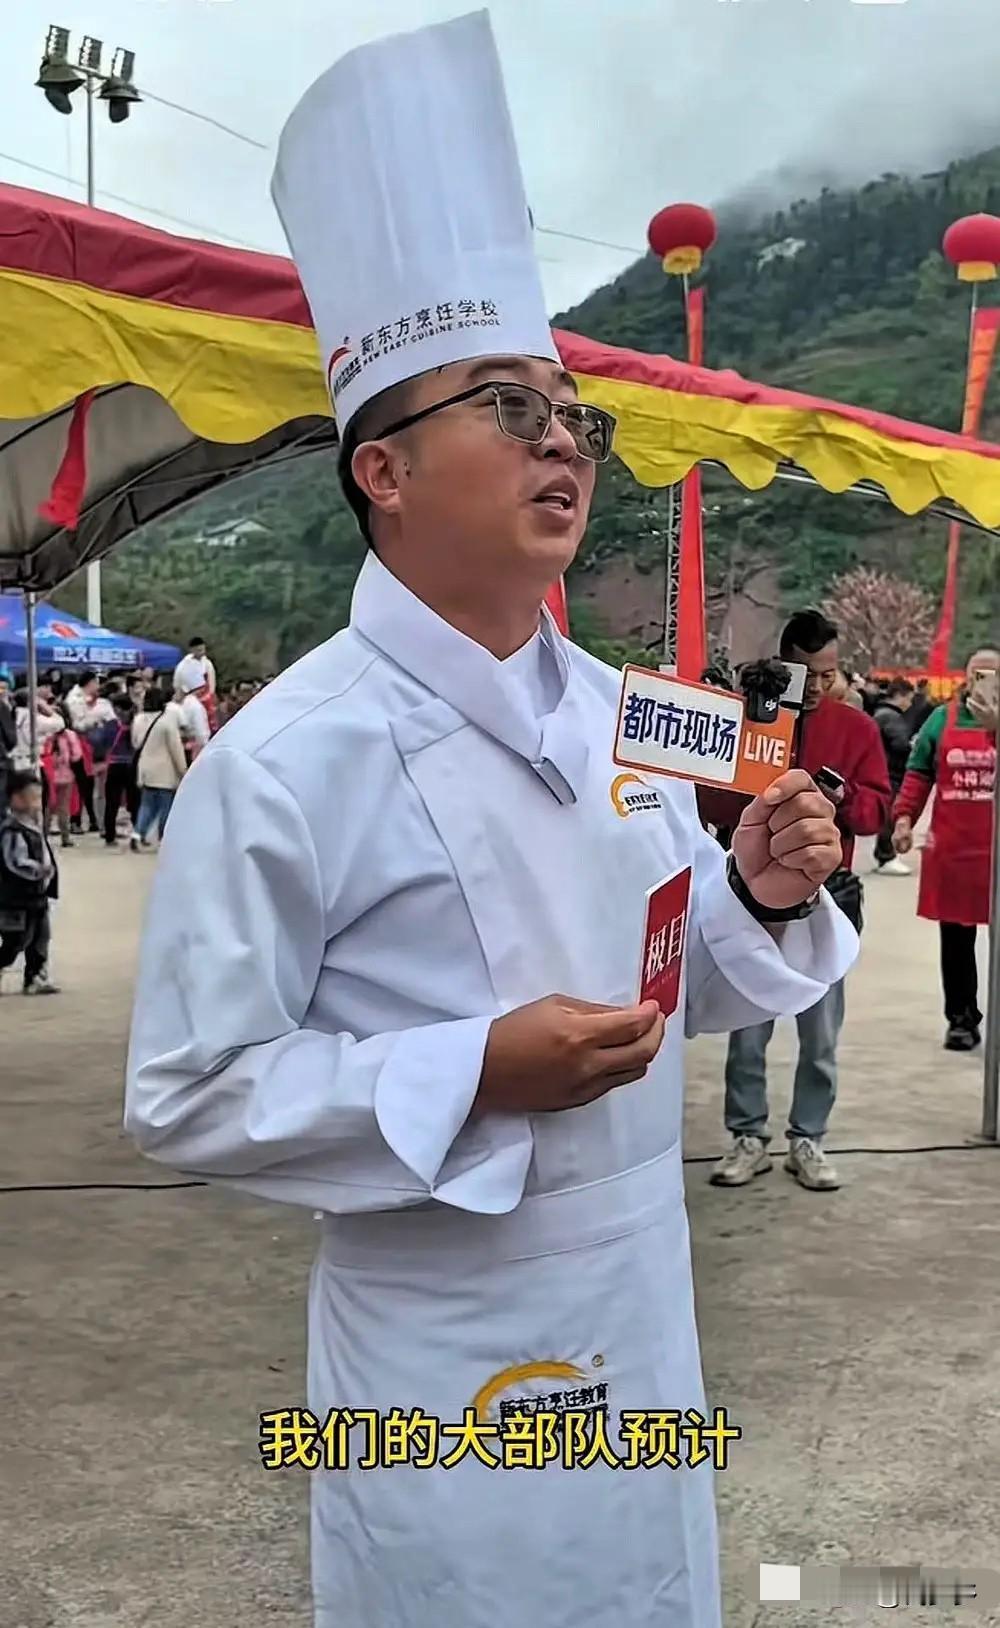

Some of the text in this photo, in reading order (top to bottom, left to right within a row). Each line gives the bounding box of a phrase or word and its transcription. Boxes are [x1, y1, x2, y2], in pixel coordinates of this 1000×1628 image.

[360, 298, 498, 356] 新东方烹饪学校
[457, 318, 501, 330] SCHOOL
[623, 692, 737, 763] 都市现场
[743, 731, 787, 767] LIVE
[645, 909, 686, 985] 极目
